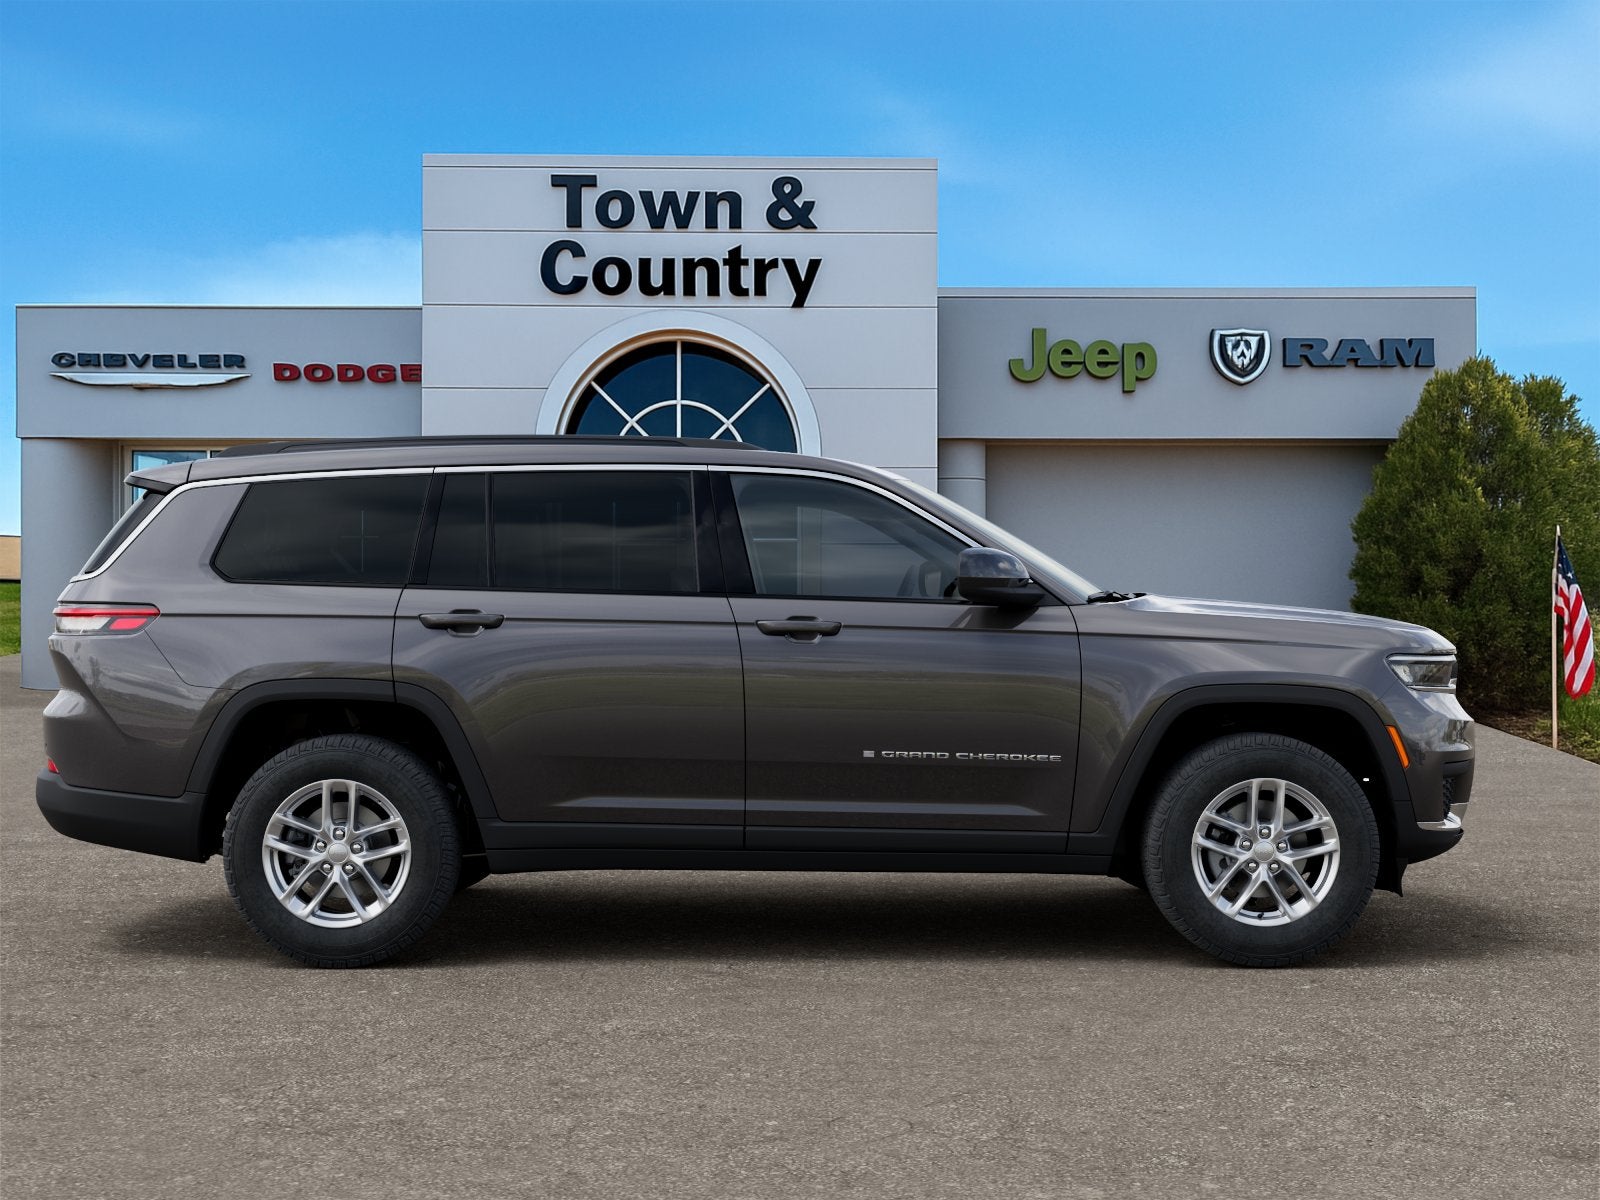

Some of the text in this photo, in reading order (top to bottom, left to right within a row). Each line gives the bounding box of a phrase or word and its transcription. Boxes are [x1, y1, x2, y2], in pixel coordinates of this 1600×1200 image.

[550, 174, 818, 230] Town &
[540, 239, 822, 308] Country
[273, 362, 422, 382] DODGE
[1008, 328, 1158, 393] Jeep
[1282, 337, 1435, 368] RAM
[881, 750, 1063, 762] GRAND CHEROKEE
